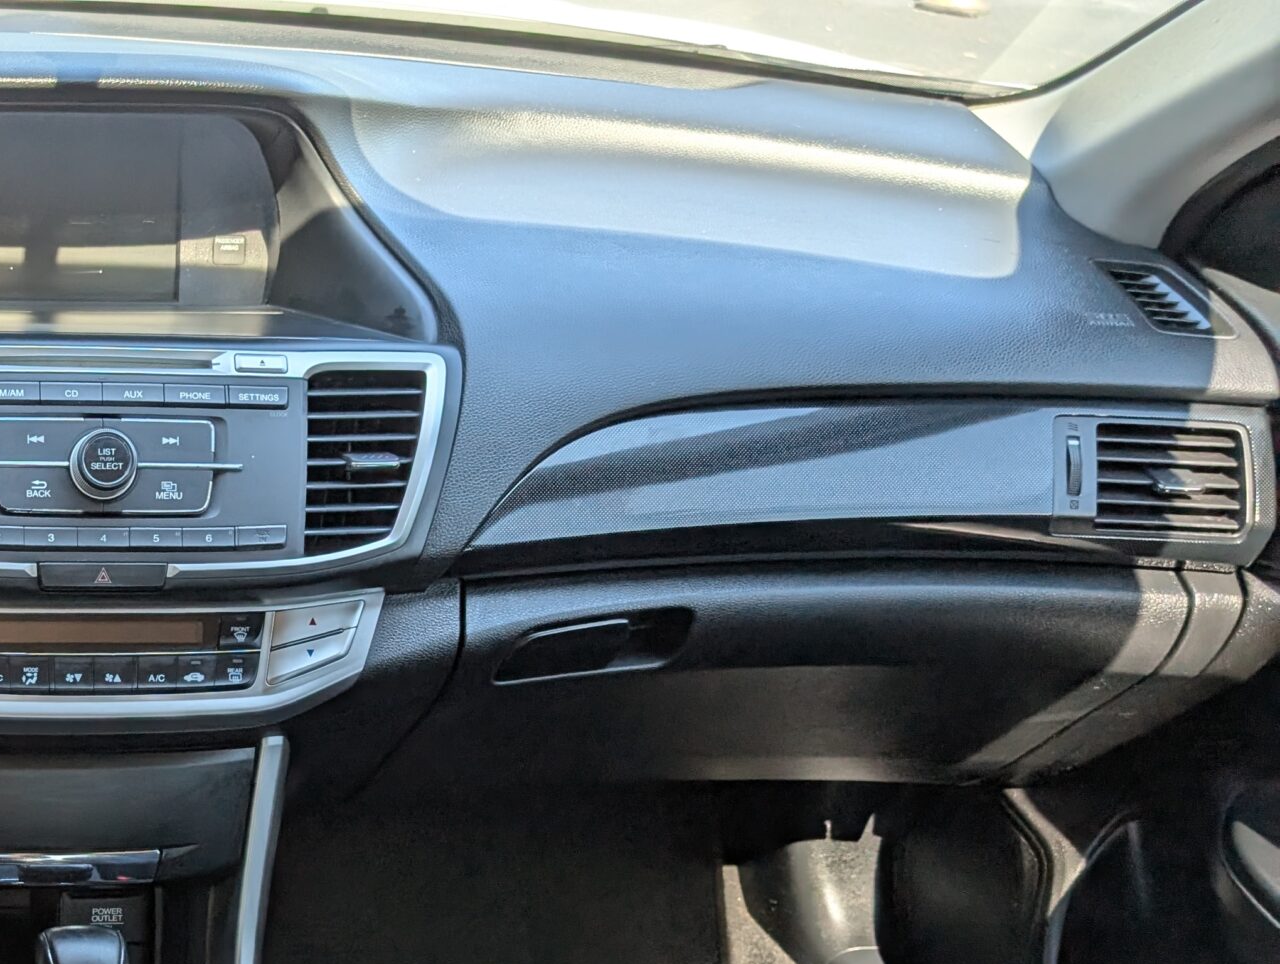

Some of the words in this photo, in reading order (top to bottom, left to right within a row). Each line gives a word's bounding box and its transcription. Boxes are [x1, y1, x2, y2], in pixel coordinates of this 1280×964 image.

[64, 390, 79, 398] CD
[179, 392, 211, 400] PHONE
[238, 393, 279, 402] SETTINGS
[97, 448, 117, 456] LIST
[90, 462, 124, 470] SELECT
[26, 489, 51, 498] BACK
[155, 492, 183, 500] MENU
[47, 533, 55, 542] 3
[99, 534, 107, 542] 4
[152, 534, 160, 543] 5
[205, 534, 213, 543] 6
[148, 674, 165, 682] A/C
[91, 907, 123, 915] POWER
